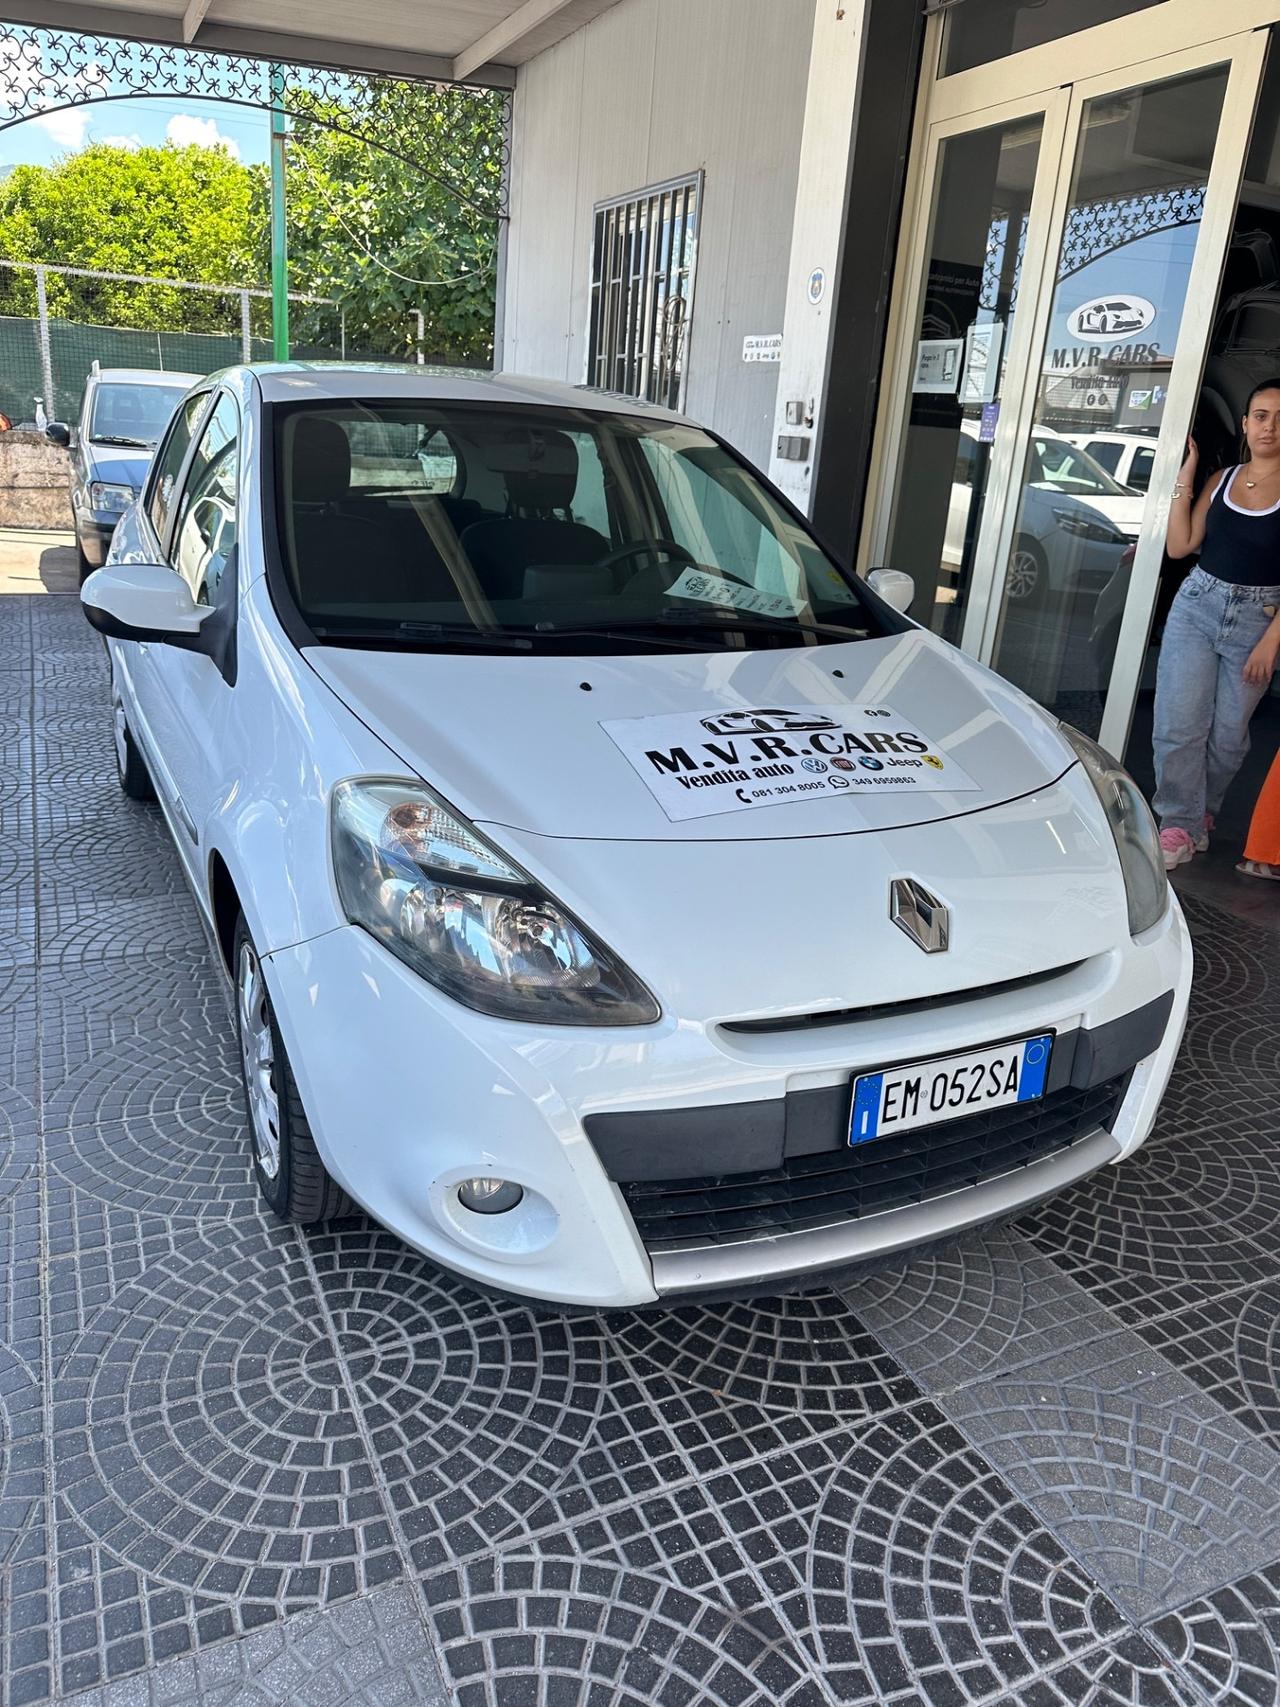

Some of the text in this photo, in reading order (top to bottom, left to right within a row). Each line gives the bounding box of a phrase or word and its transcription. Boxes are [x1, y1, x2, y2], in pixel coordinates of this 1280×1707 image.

[886, 757, 923, 768] Jeep
[754, 761, 795, 779] auto
[852, 777, 872, 786] 349
[752, 781, 826, 798] 081 304 8005
